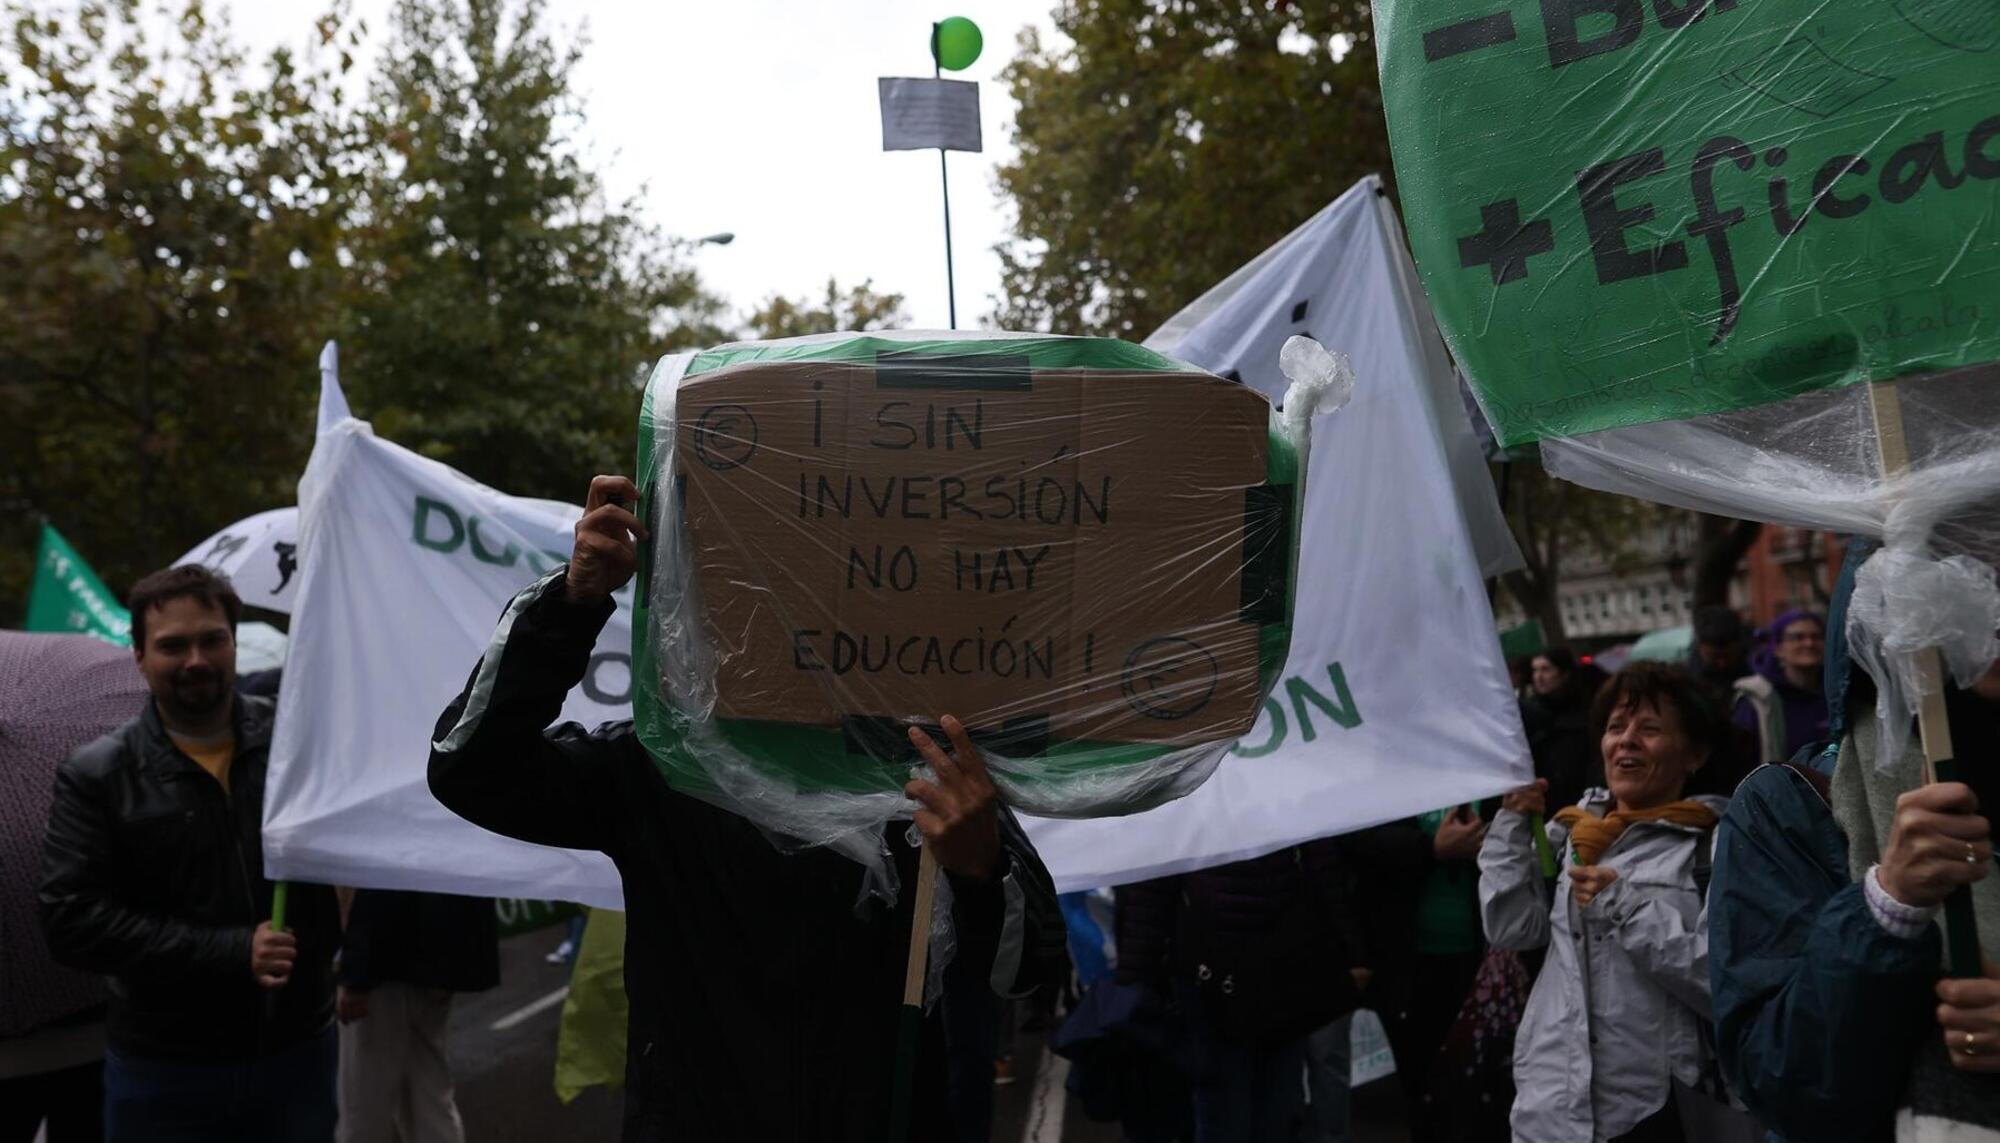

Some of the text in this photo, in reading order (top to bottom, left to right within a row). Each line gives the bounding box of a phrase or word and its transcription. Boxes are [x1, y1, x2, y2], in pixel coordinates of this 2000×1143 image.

[870, 398, 983, 450] SIN
[798, 445, 1112, 525] INVERSIÓN
[846, 545, 1051, 593] NO HAY
[793, 615, 1054, 680] EDUCACIÓN
